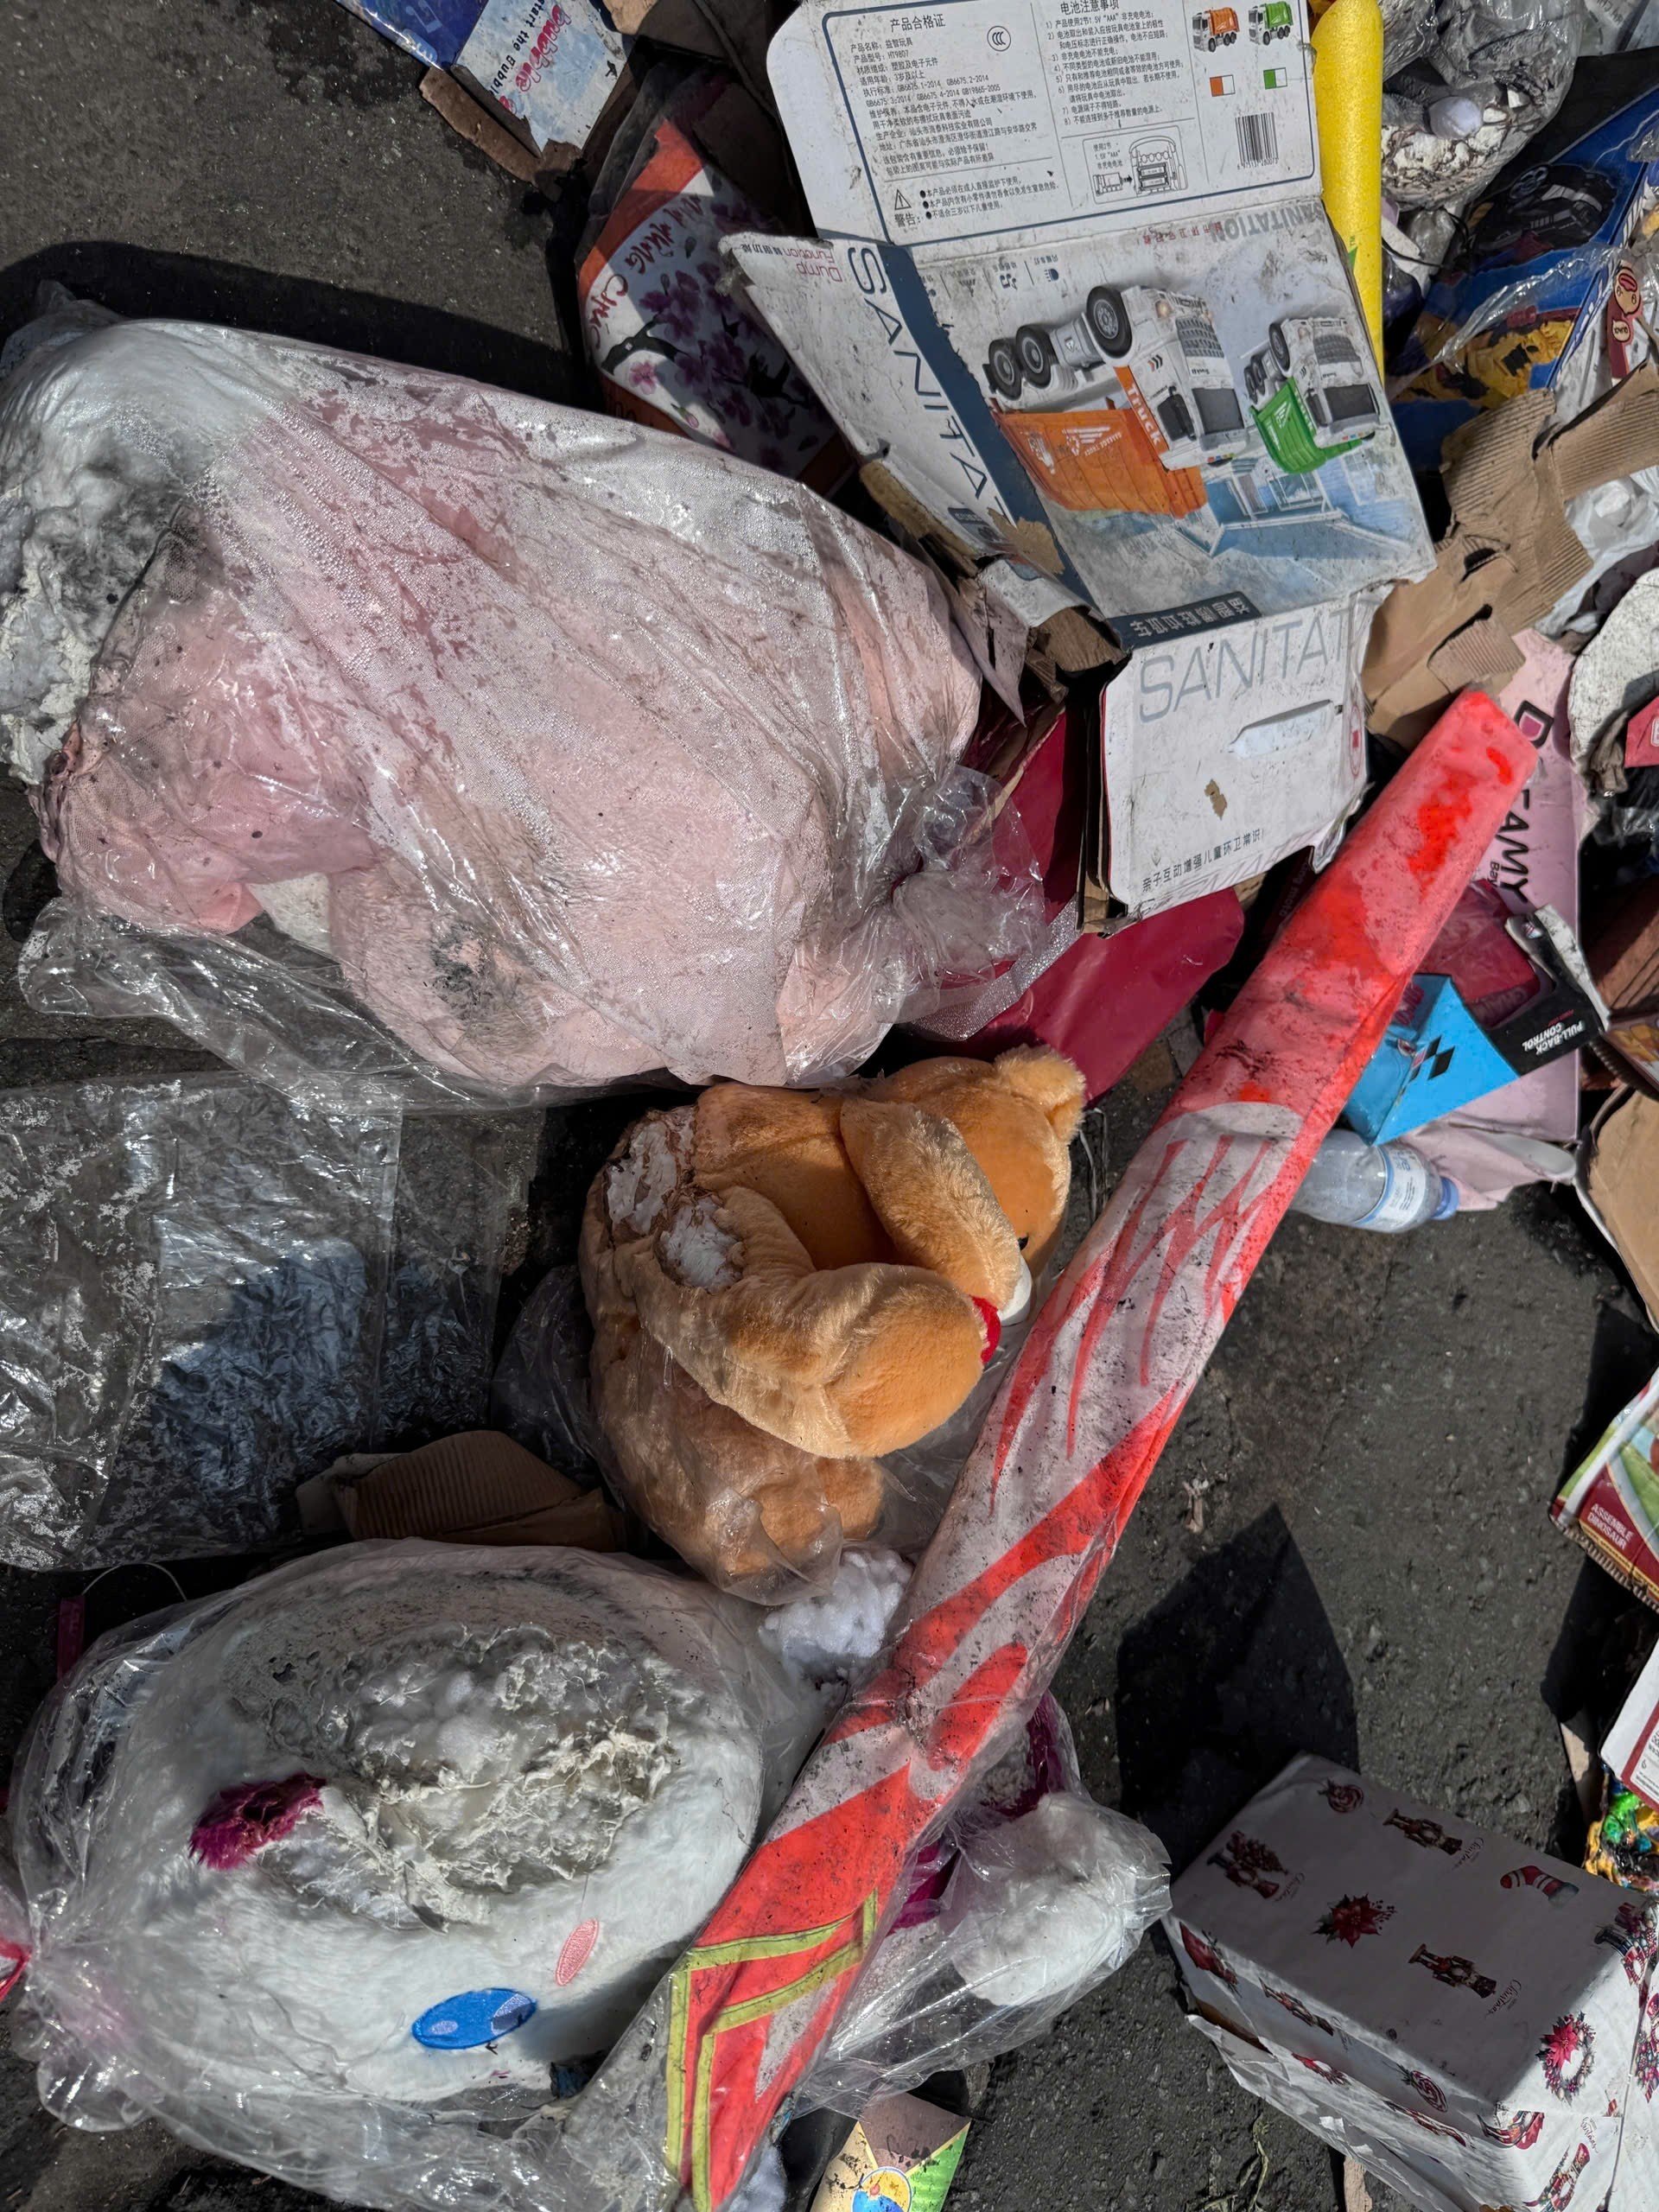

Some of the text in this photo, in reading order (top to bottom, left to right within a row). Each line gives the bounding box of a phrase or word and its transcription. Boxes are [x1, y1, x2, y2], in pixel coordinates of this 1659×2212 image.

[890, 13, 945, 33] 产品合格证
[1060, 0, 1119, 16] 电池注意事项
[1208, 201, 1325, 243] SANITATION
[797, 262, 843, 282] Dump
[1128, 384, 1161, 446] Truck
[1522, 1022, 1562, 1051] CONTROL
[1535, 1020, 1586, 1055] PULL-BACK
[1586, 1512, 1627, 1550] DINOSAUR
[1591, 1503, 1634, 1541] ASSEMBLE
[1489, 1979, 1522, 2017] Christmas
[1581, 2114, 1598, 2153] Christmas
